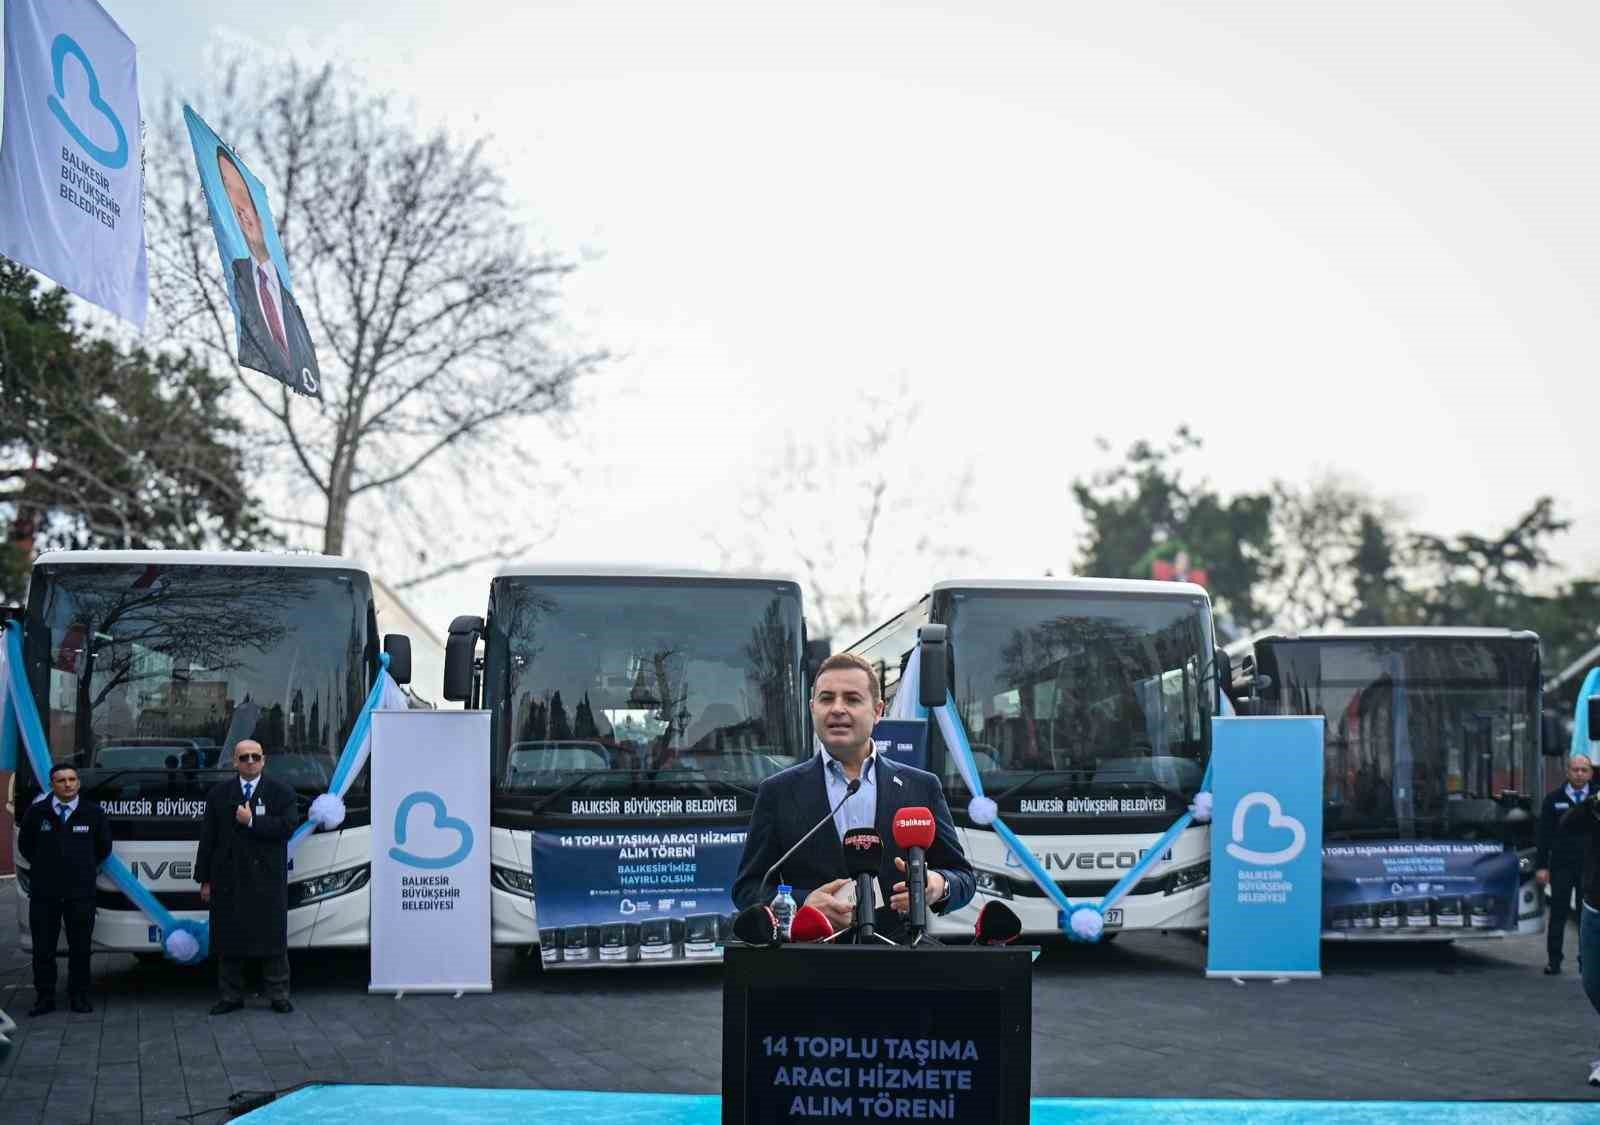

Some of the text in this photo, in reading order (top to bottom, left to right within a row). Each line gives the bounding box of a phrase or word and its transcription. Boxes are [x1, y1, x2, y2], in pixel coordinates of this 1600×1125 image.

[62, 146, 110, 193] BALIKESİR
[61, 165, 121, 217] BÜYÜKŞEHİR
[60, 184, 115, 232] BELEDİYESİ
[157, 798, 207, 818] BÜYÜKŞE
[571, 796, 737, 816] BALIKESİR BÜYÜKŞEHİR BELEDİYESİ
[1020, 796, 1166, 815] BALIKESİR BÜYÜKŞEHİR BELEDİYESİ
[560, 836, 572, 847] 14
[575, 835, 614, 846] TOPLU
[616, 834, 660, 847] TAŞIMA
[663, 833, 697, 844] ARACI
[619, 845, 695, 859] ALIM TÖRENİ
[1045, 852, 1136, 870] IVECO
[131, 861, 198, 880] IVE
[661, 874, 694, 884] OLSUN
[402, 875, 449, 886] BALIKESİR
[402, 887, 460, 899] BÜYÜKŞEHİR
[402, 899, 454, 910] BELEDİYESİ
[1106, 912, 1119, 923] 37
[762, 1036, 979, 1065] 14 TOPLU TAŞIMA
[773, 1063, 972, 1089] ARACI HİZMETE
[789, 1093, 955, 1119] ALIM TÖRENİ
